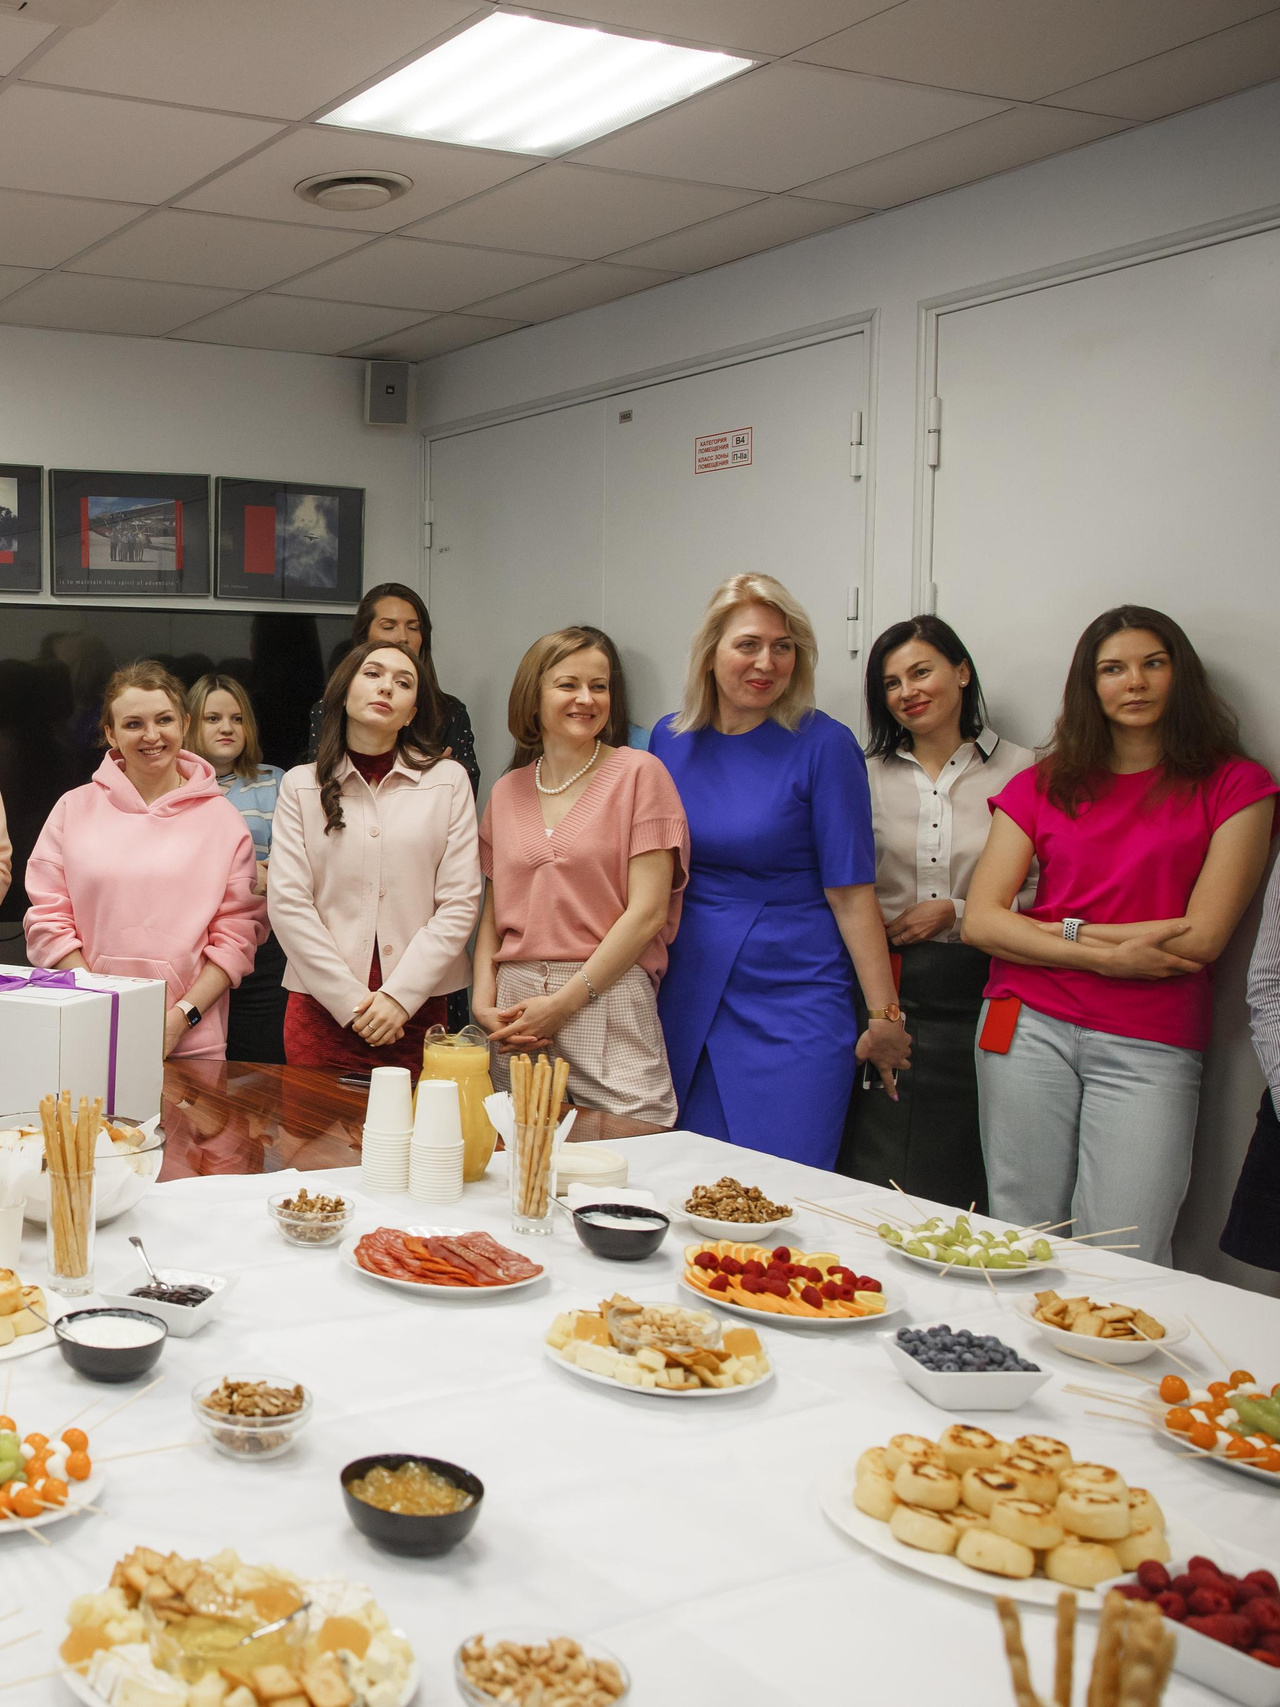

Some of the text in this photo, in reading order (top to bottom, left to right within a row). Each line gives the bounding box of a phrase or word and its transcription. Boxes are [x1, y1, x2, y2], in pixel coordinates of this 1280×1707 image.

[700, 437, 727, 447] КАТЕГОРИЯ
[698, 444, 729, 454] ПОМЕЩЕНИЯ
[698, 453, 729, 463] КЛАСС ЗОНЫ
[698, 460, 729, 470] ПОМЕЩЕНИЯ
